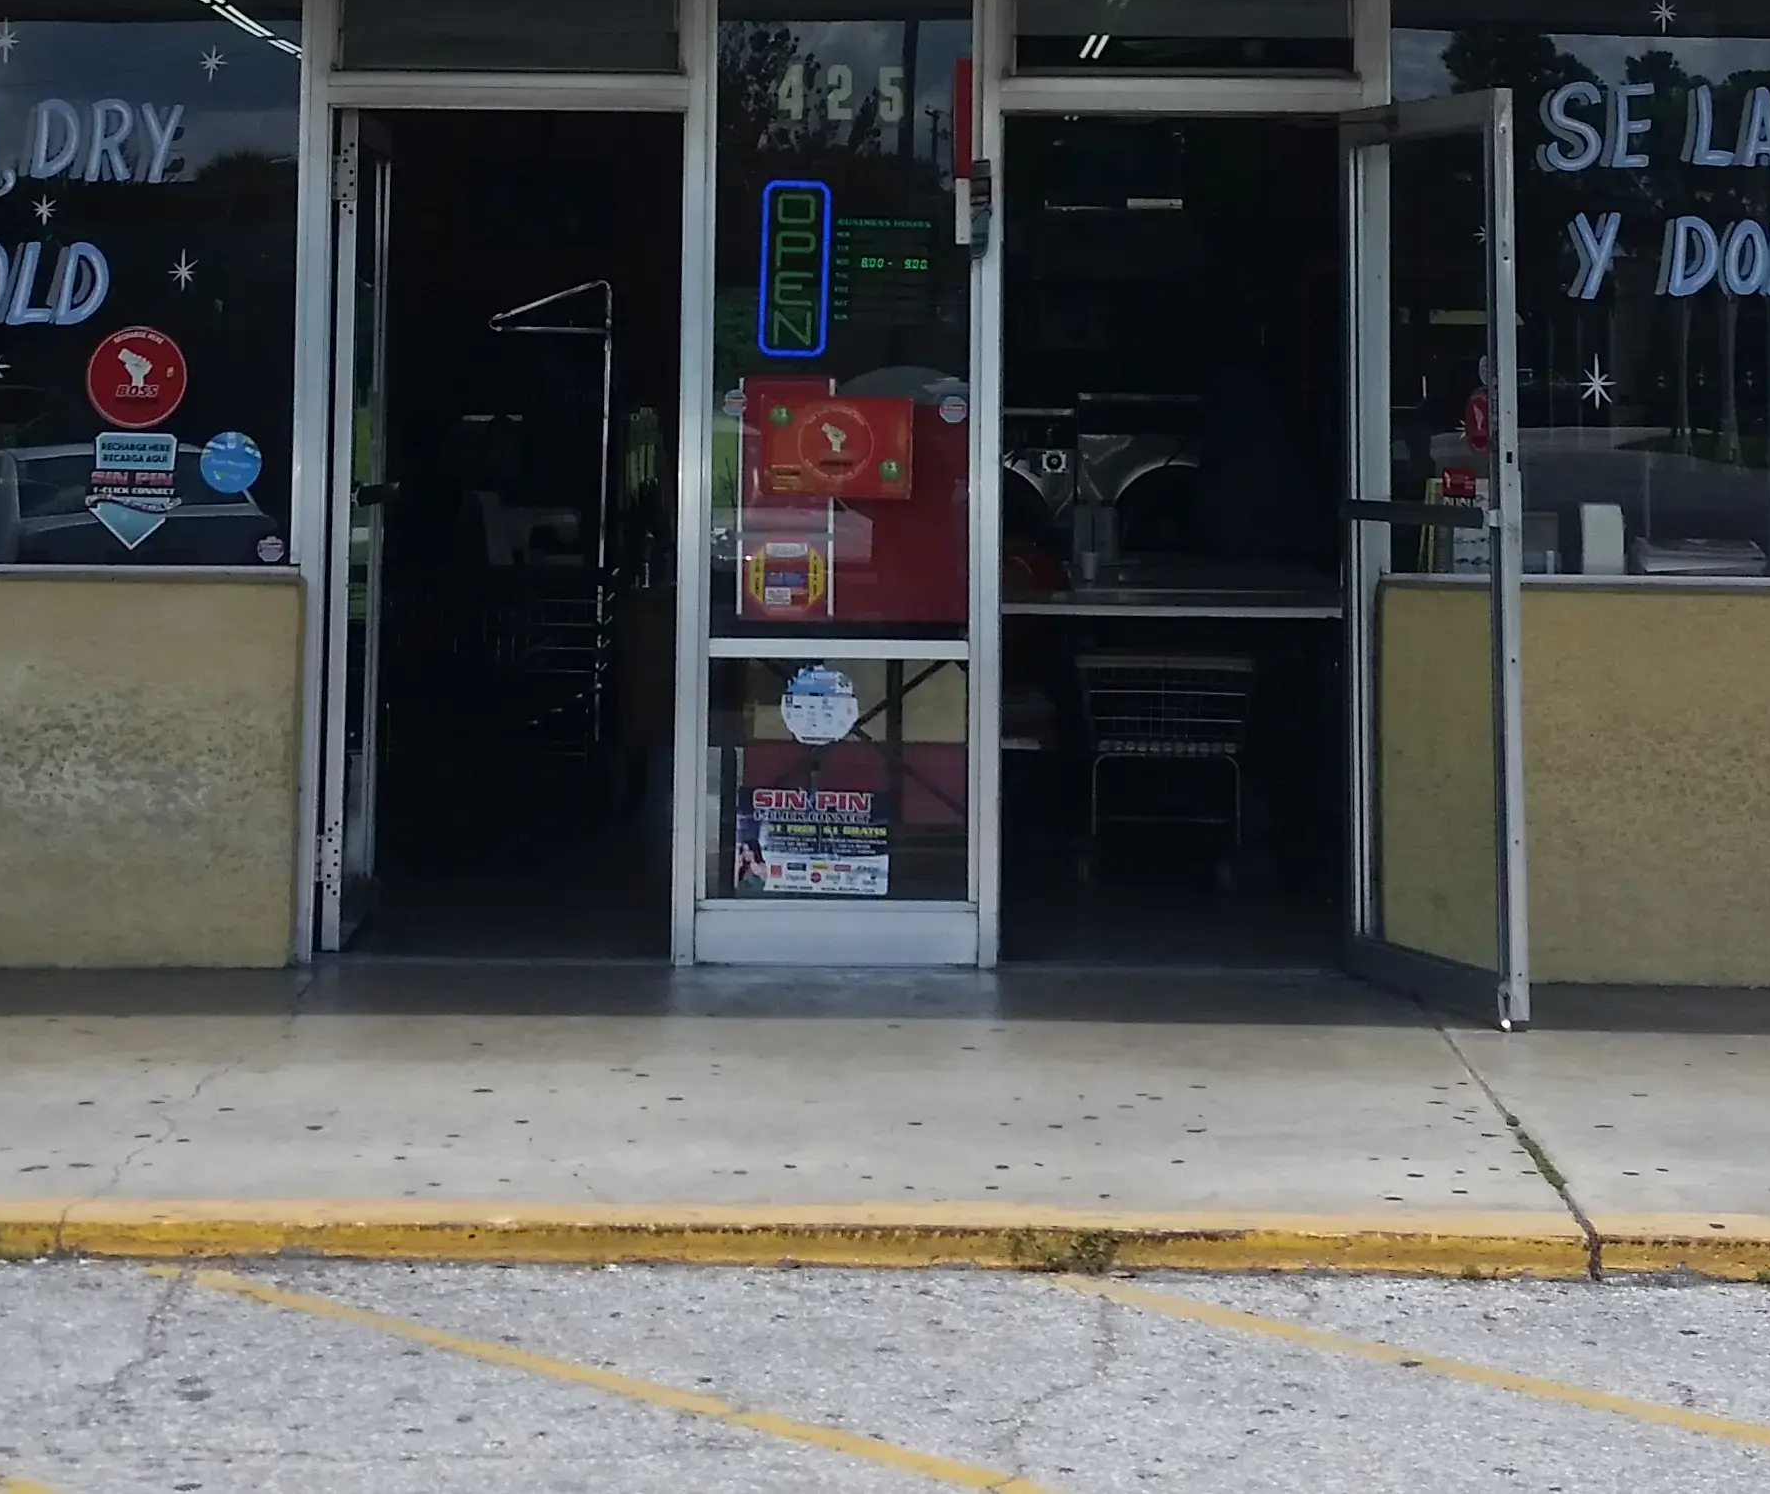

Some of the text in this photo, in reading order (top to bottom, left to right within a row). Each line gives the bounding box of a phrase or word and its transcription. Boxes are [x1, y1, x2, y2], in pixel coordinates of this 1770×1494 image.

[777, 63, 905, 123] 425
[1537, 81, 1655, 174] SE
[1567, 212, 1622, 299] Y
[772, 193, 817, 346] OPEN
[115, 385, 159, 397] BOSS
[101, 442, 171, 452] RECHARGE HERE
[103, 454, 143, 463] RECARGA
[91, 471, 174, 486] SIN PIN
[753, 789, 871, 813] SIN PIN
[809, 811, 871, 823] CONNECT
[843, 827, 888, 835] GRATIS
